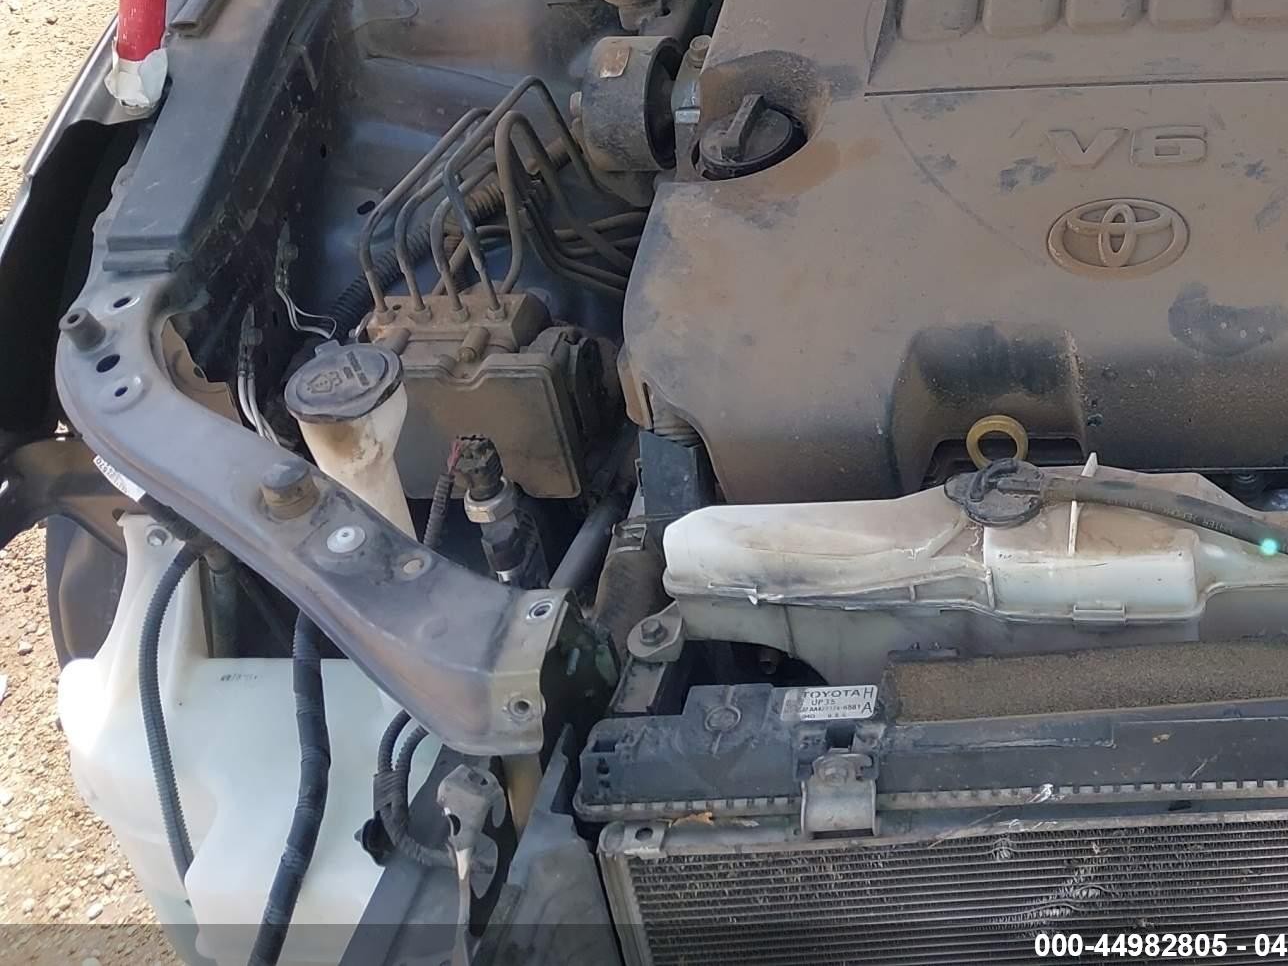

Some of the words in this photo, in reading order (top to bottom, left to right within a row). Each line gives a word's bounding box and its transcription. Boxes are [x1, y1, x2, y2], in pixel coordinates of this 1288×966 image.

[1047, 125, 1208, 169] V6
[803, 690, 860, 698] TOYOTA
[864, 687, 874, 699] H
[861, 701, 873, 713] A
